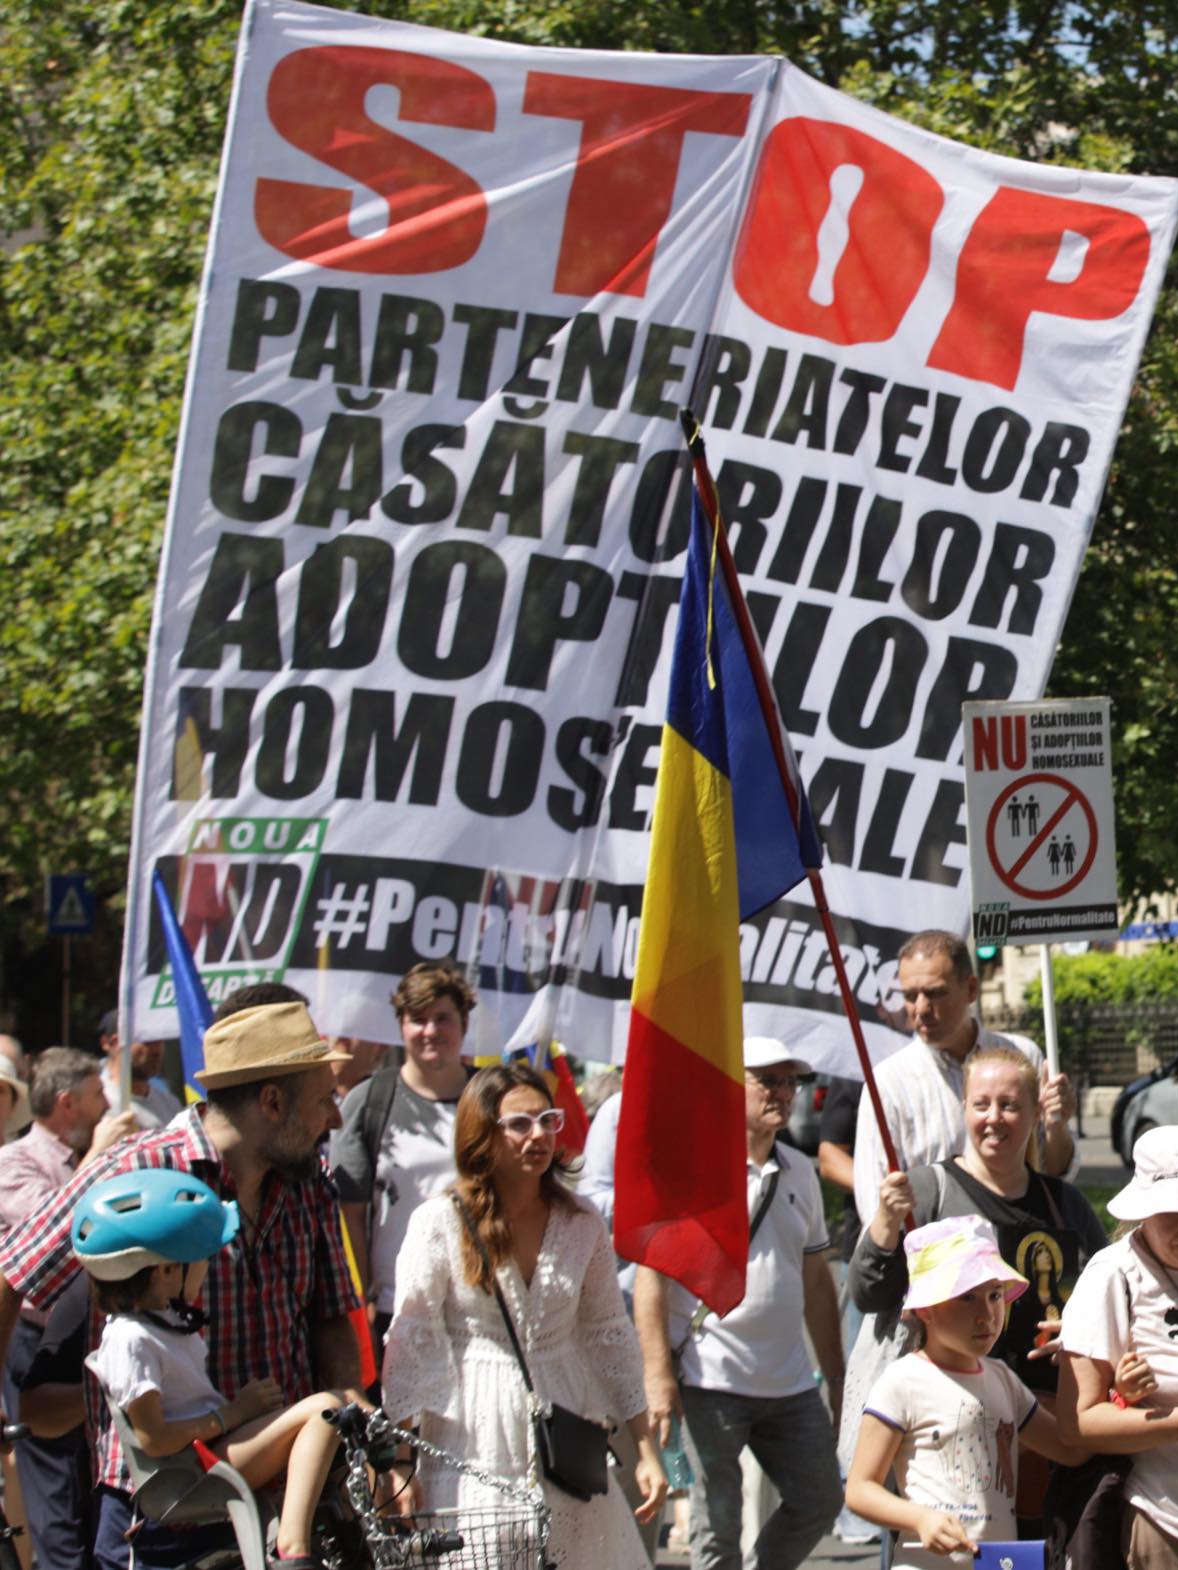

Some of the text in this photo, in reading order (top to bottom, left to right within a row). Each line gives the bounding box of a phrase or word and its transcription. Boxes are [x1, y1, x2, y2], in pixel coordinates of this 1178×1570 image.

[254, 45, 1151, 391] STOP
[226, 279, 1092, 509] PARTENERIATELOR
[972, 715, 1027, 772] NU
[1032, 752, 1105, 770] HOMOSEXUALE
[169, 685, 969, 888] HOMOSEALE
[192, 821, 322, 850] NOUA
[979, 913, 1006, 937] ND
[1010, 910, 1116, 930] #PentruNormalitate
